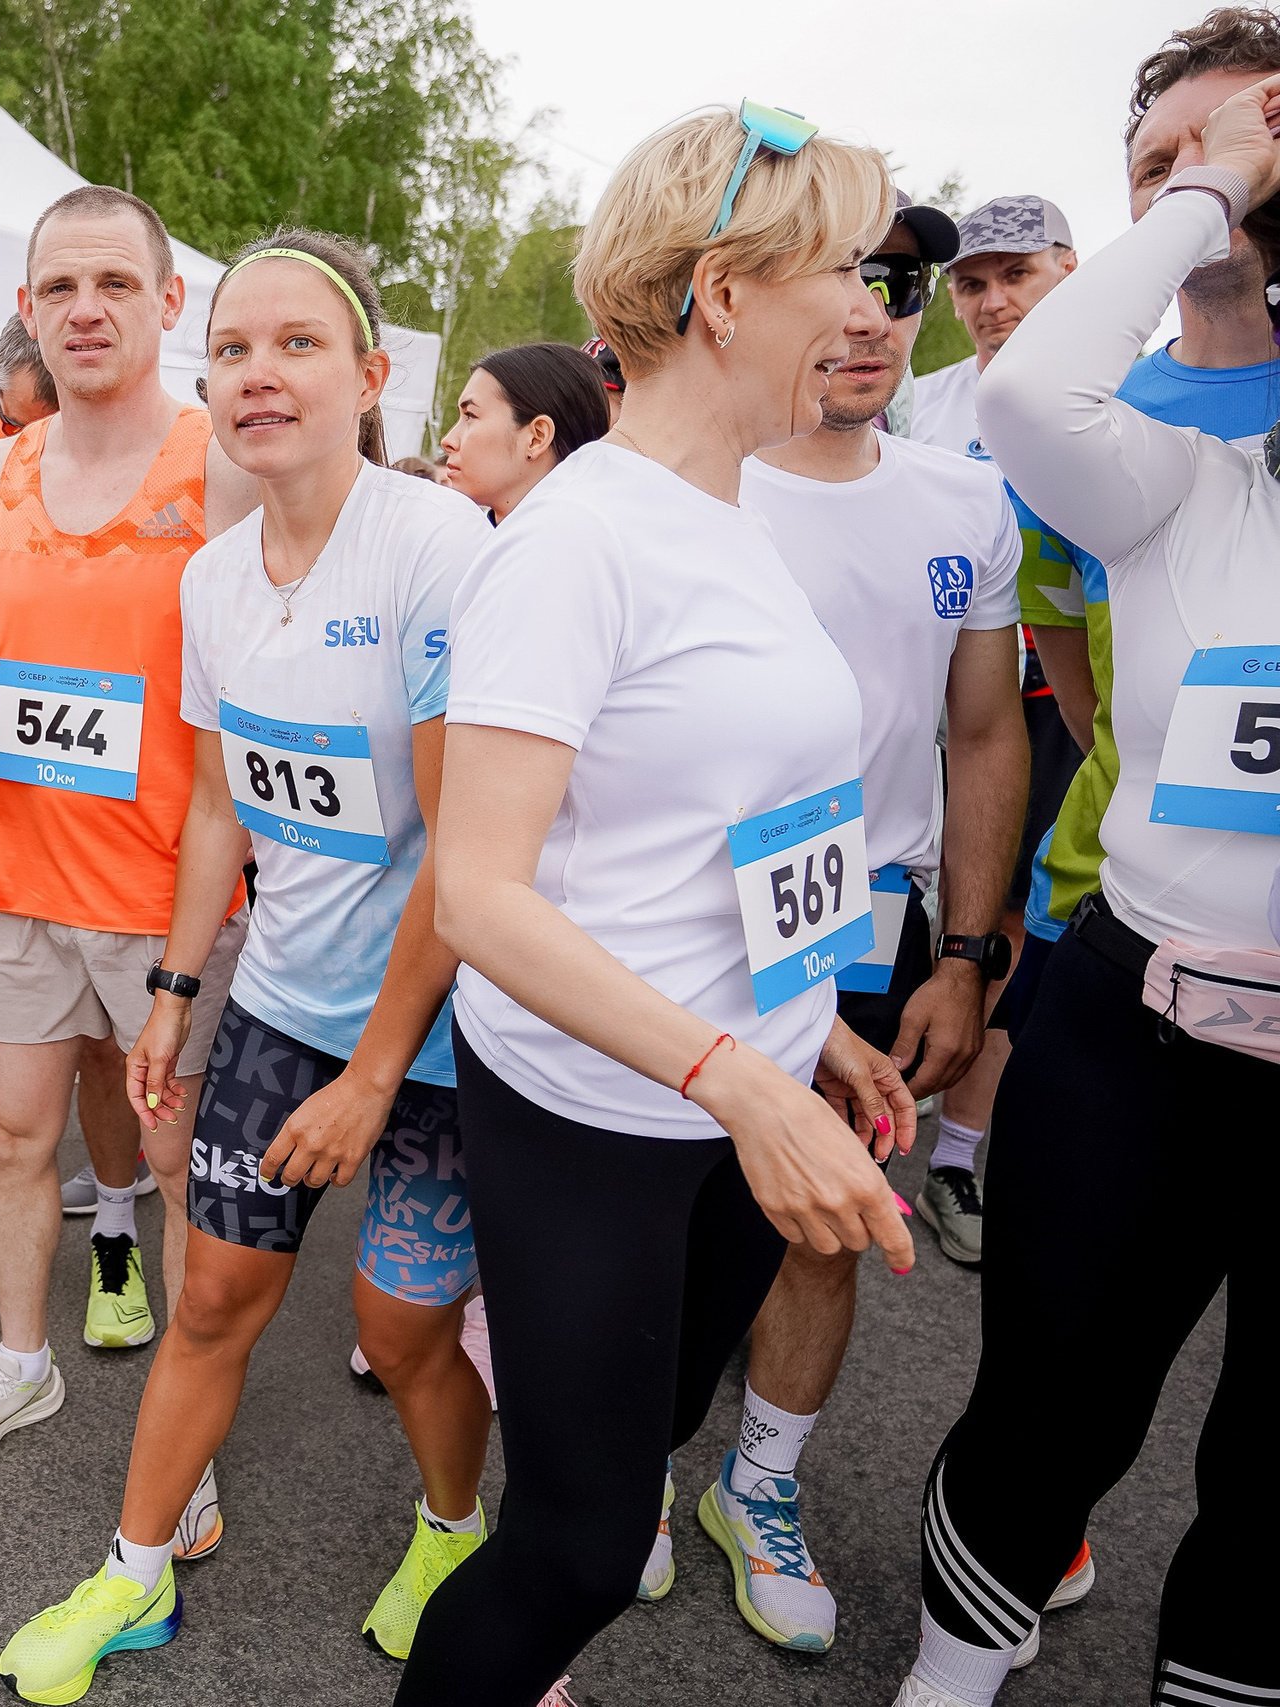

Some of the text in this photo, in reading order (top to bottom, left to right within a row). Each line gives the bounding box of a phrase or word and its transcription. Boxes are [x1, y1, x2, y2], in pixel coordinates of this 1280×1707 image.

[136, 524, 193, 539] adidas
[424, 629, 451, 659] S
[27, 672, 47, 682] СБЕР
[16, 699, 108, 756] 544
[245, 721, 261, 732] СБЕР
[245, 750, 341, 817] 813
[770, 823, 789, 838] СБЕР
[770, 843, 844, 939] 569
[744, 1406, 780, 1438] ВАЛО
